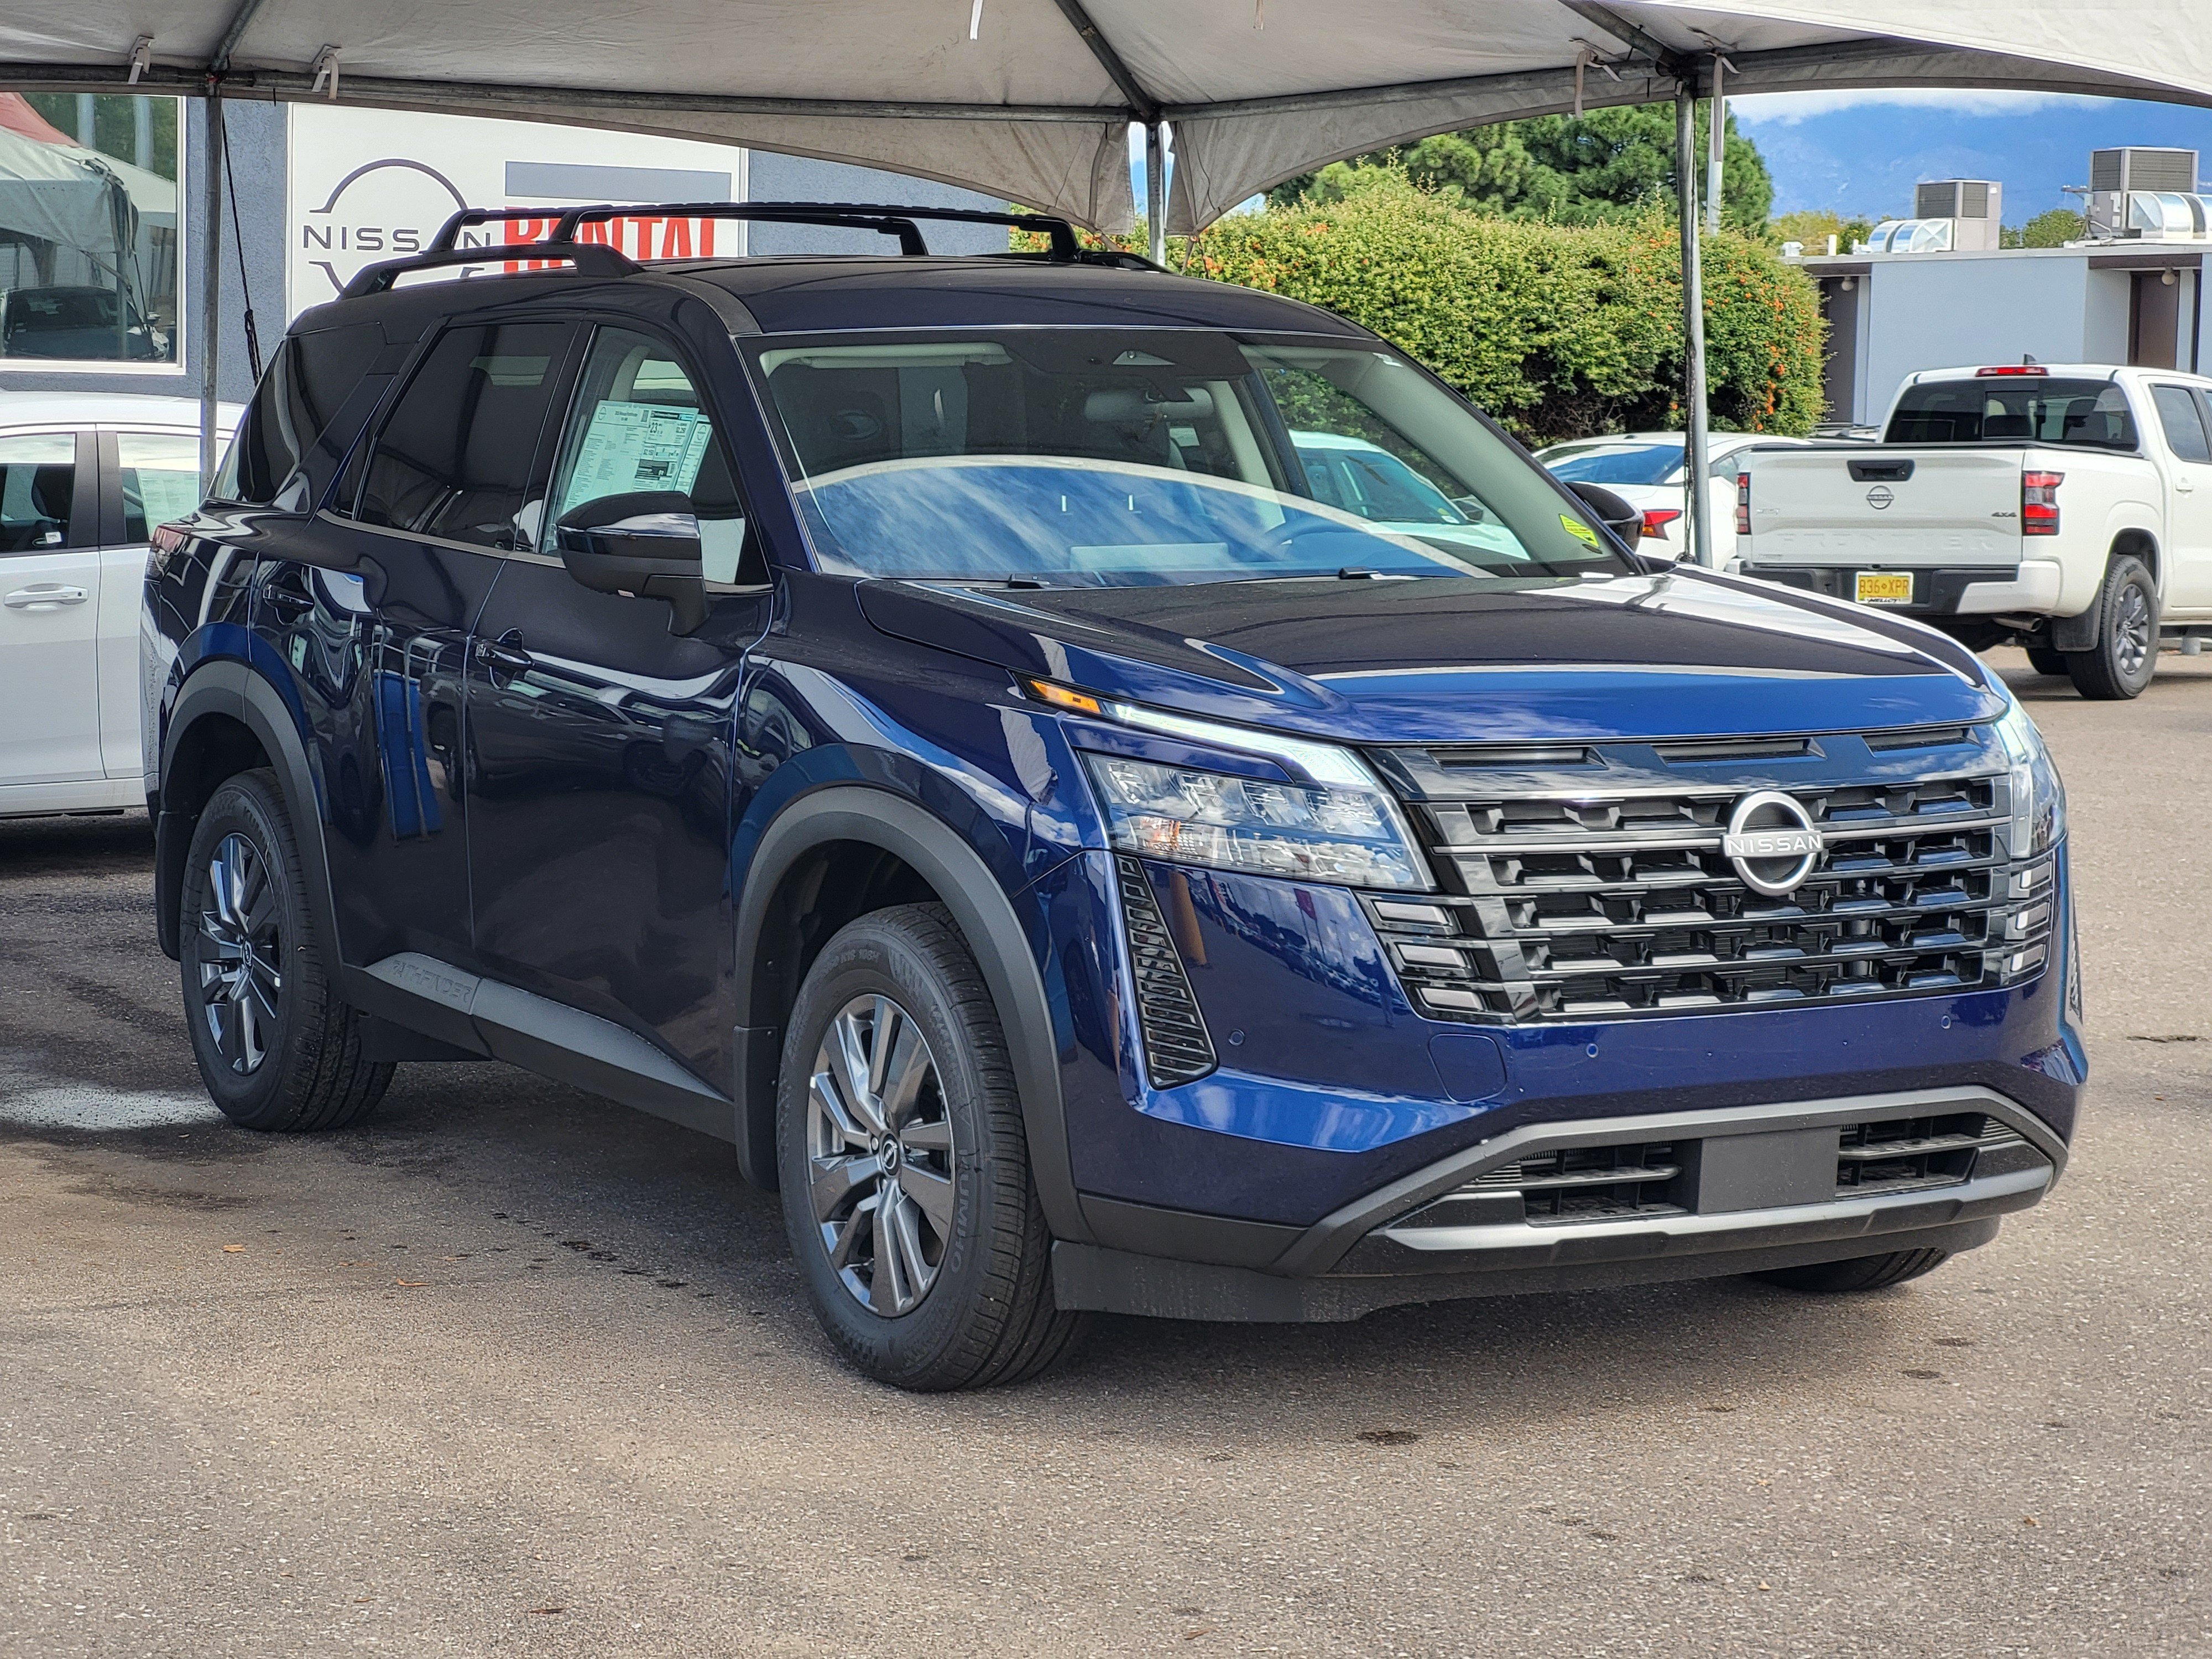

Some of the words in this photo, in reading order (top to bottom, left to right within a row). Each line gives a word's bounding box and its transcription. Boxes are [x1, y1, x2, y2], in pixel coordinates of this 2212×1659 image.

[303, 225, 491, 251] NISSN
[504, 206, 714, 274] RNTA
[1726, 834, 1822, 854] NISSAN
[393, 959, 473, 1003] PATHFINDER
